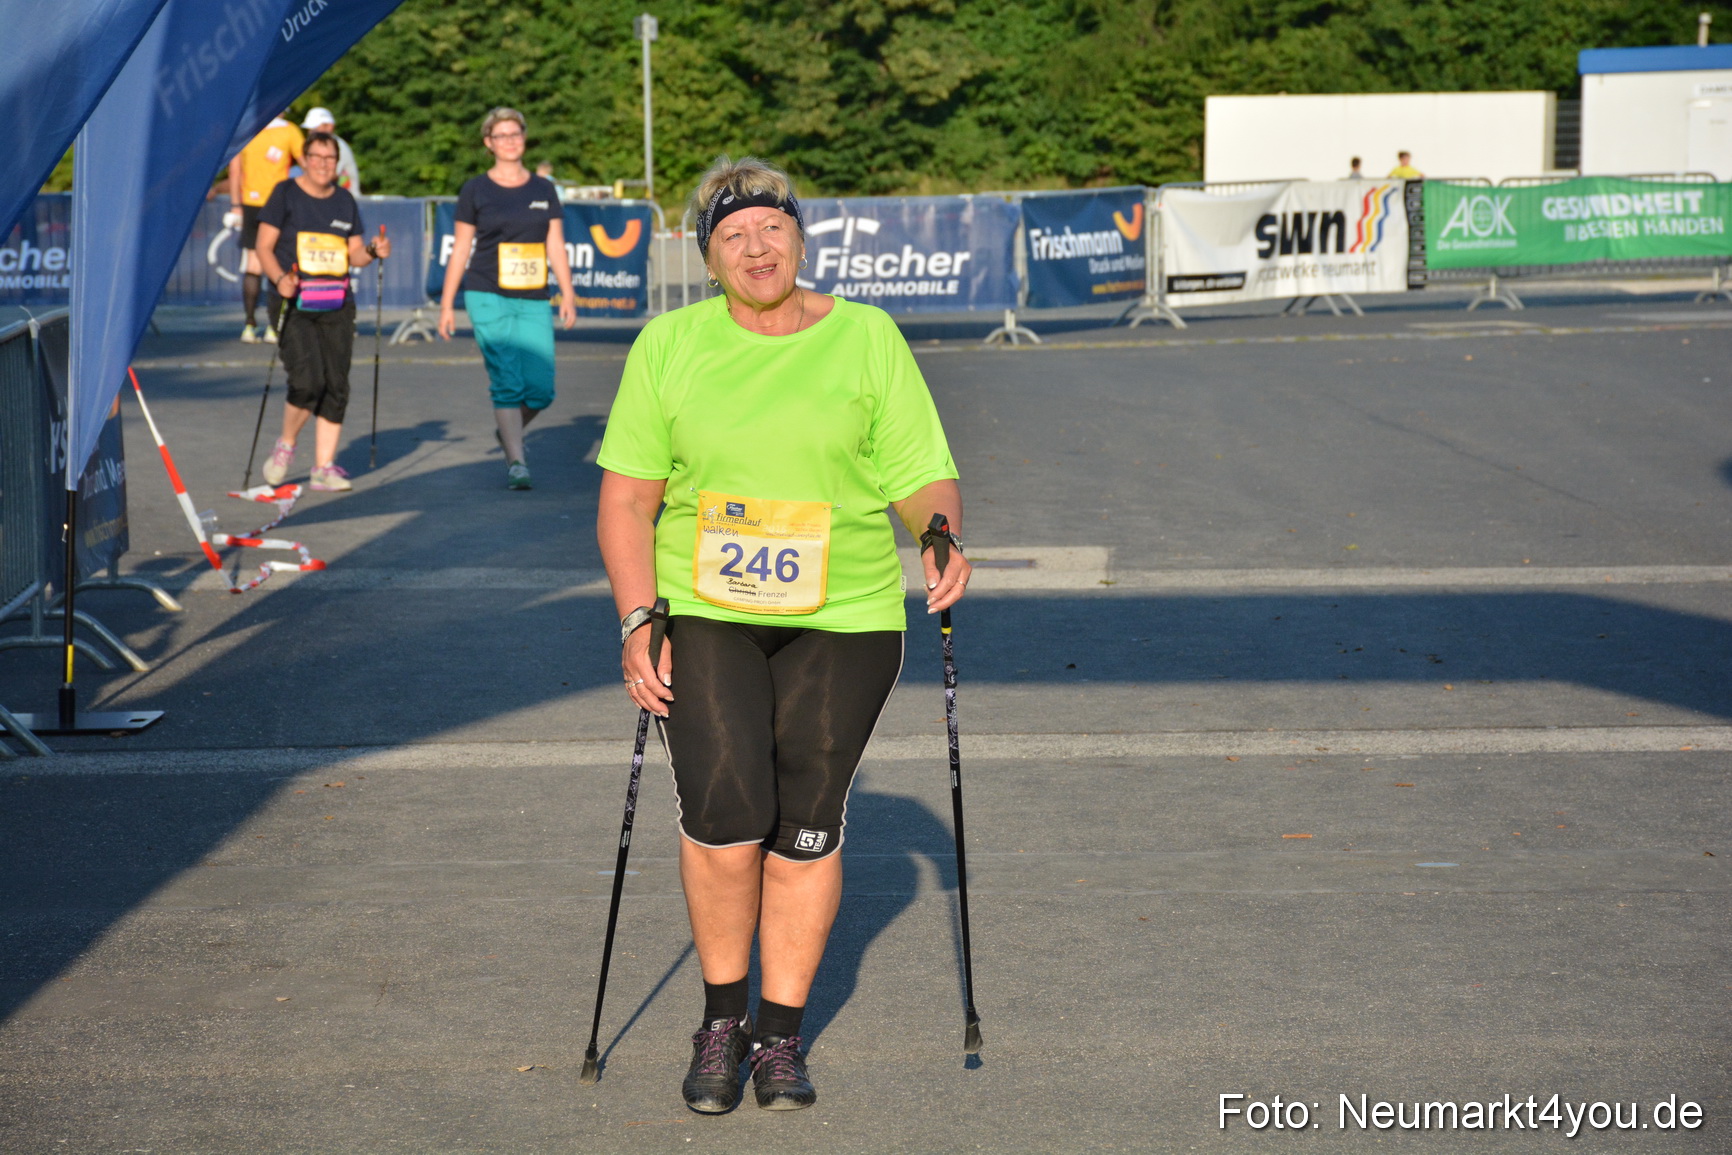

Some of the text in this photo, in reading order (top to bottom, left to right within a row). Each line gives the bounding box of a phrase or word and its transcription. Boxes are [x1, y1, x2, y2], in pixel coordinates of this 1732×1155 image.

[1541, 190, 1704, 220] GESUNDHEIT
[1440, 194, 1516, 238] AOK
[1254, 210, 1346, 260] swn
[1642, 216, 1725, 236] HÄNDEN
[1029, 226, 1123, 261] Frischmann
[307, 251, 337, 264] 757
[815, 244, 971, 280] Fischer
[510, 262, 538, 276] 735
[593, 269, 641, 289] Medien
[830, 280, 960, 298] AUTOMOBILE
[716, 512, 762, 527] firmenlauf
[703, 525, 739, 538] walken
[719, 542, 800, 583] 246
[726, 577, 758, 589] Barbara
[757, 591, 788, 599] Frenzel
[800, 832, 815, 848] 5
